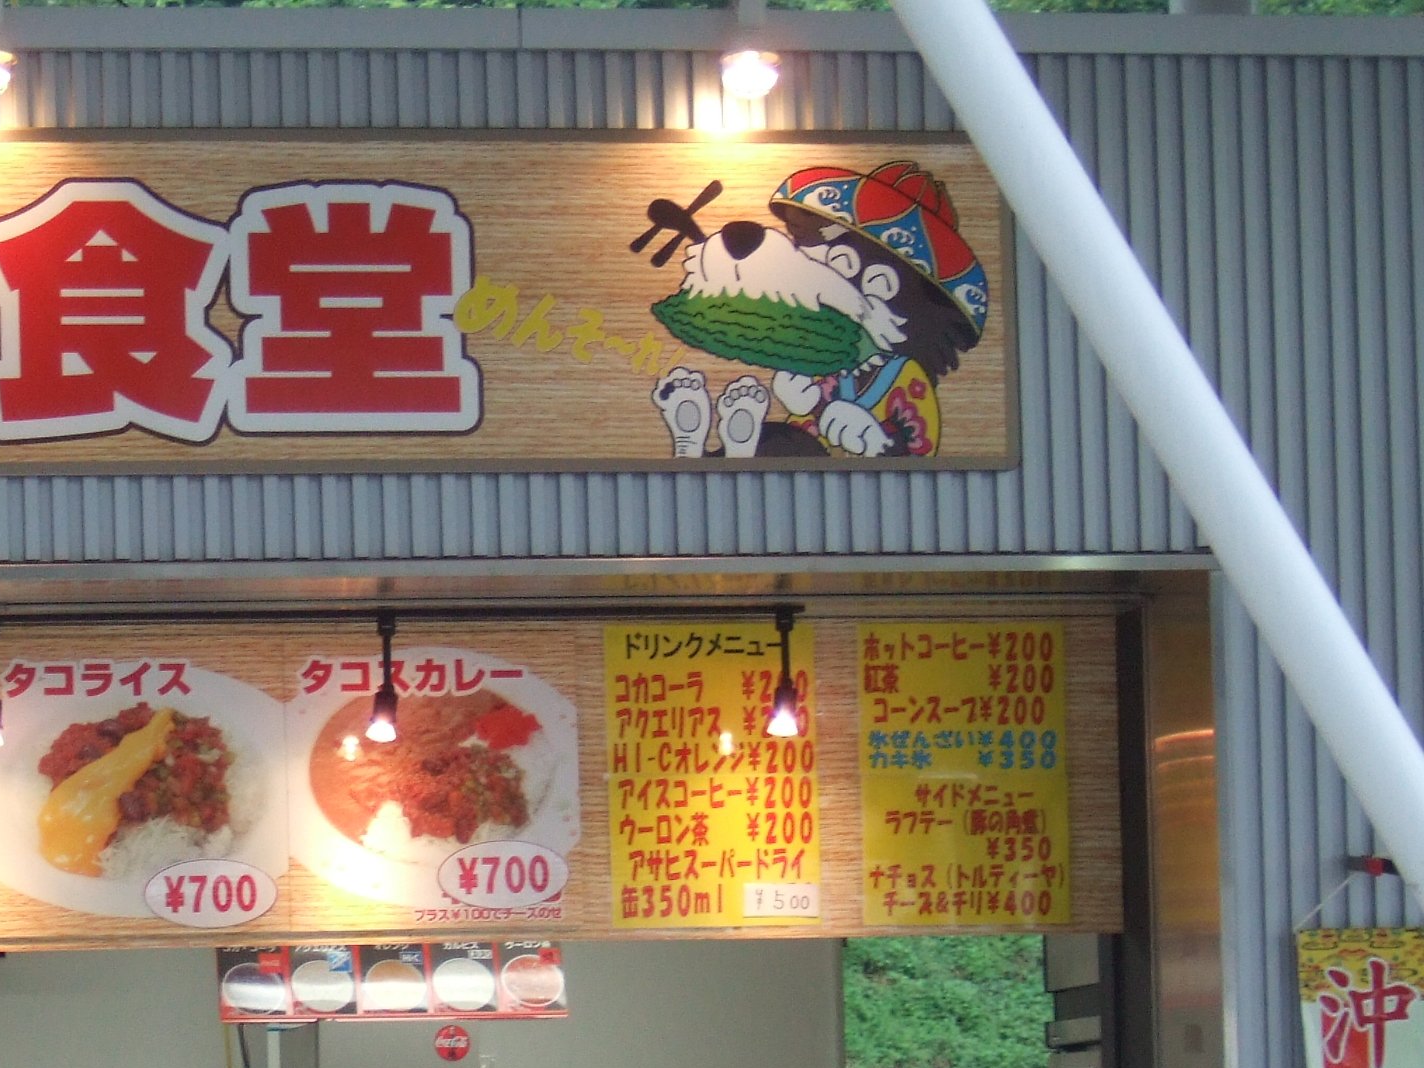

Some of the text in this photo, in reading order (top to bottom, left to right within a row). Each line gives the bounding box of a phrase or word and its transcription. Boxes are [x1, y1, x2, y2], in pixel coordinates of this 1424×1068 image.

[626, 632, 782, 660] ドリンクメニュー
[4, 661, 191, 697] タコライス
[302, 658, 524, 695] タコスカレー
[615, 670, 809, 703] コカコーラ ¥20
[988, 663, 1054, 694] ¥200
[616, 707, 721, 738] アクエリアス
[978, 750, 1057, 770] ¥350
[914, 783, 1034, 808] サイドメニュー
[619, 811, 813, 846] ウーロン茶 ¥200
[884, 809, 953, 835] ラフテー
[986, 836, 1052, 861] ¥350
[458, 855, 550, 895] ¥700
[628, 849, 805, 881] アサヒスーパードライ
[869, 863, 937, 889] ナチョス
[165, 874, 257, 913] ¥700
